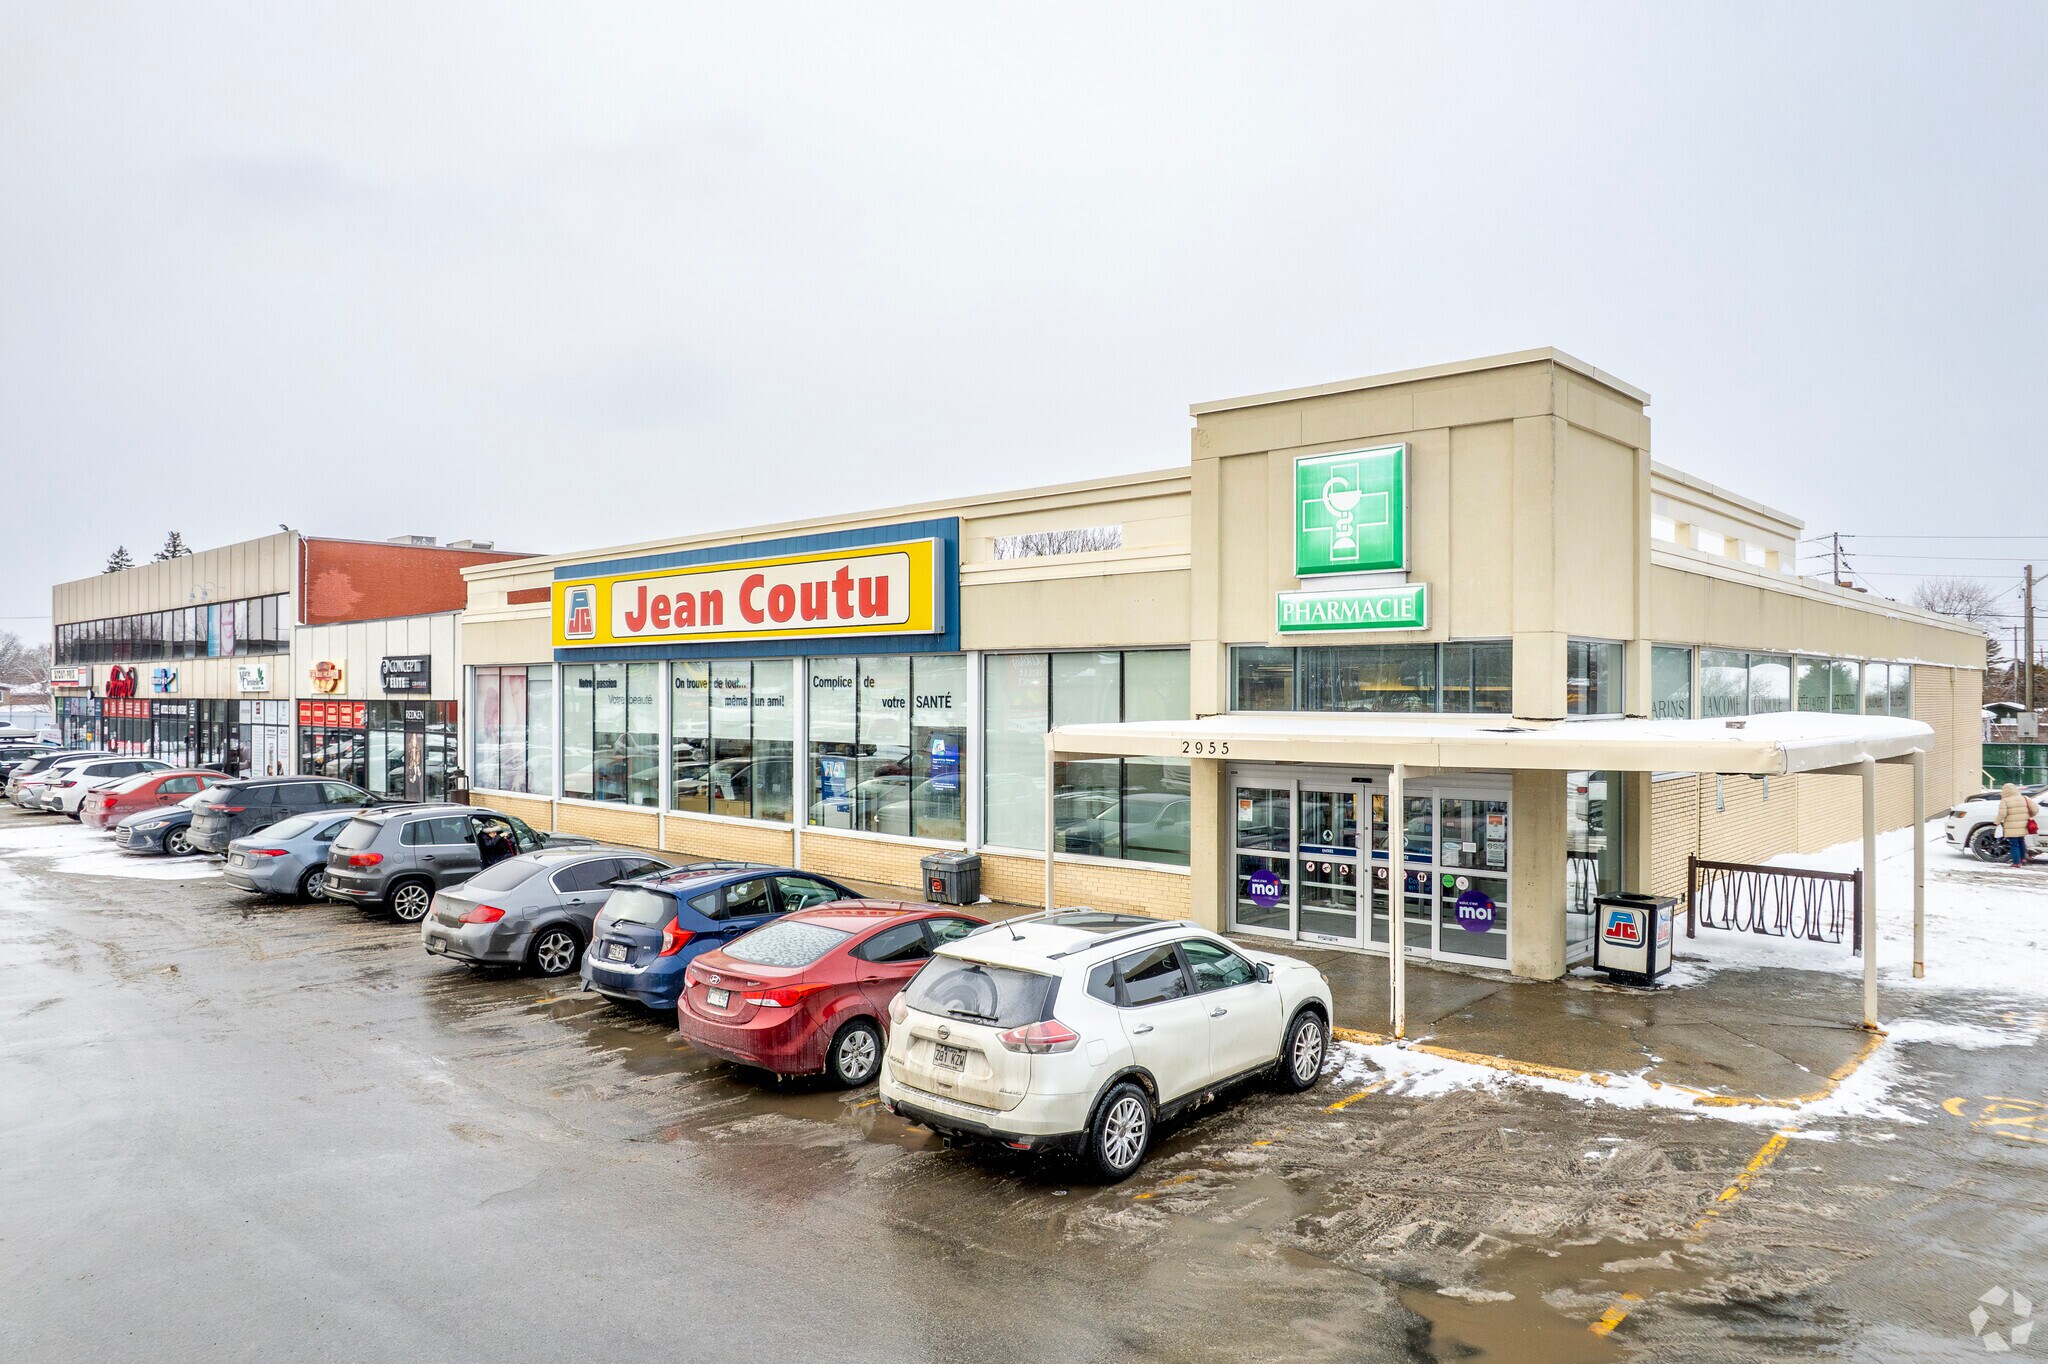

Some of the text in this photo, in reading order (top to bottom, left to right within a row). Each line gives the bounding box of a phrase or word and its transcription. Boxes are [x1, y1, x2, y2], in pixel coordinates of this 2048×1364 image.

[624, 565, 889, 632] Jean Coutu
[1283, 597, 1412, 622] PHARMACIE
[675, 677, 685, 689] On
[686, 677, 708, 689] trouve
[713, 677, 723, 689] de
[813, 675, 875, 691] Complice de
[608, 694, 653, 705] Votre beauté
[724, 694, 785, 707] même un ami!
[881, 691, 952, 709] votre SANTÉ
[405, 709, 424, 720] REDKEN
[1651, 699, 1685, 719] ARINS
[1182, 740, 1230, 755] 2955
[1251, 879, 1279, 897] moi
[1458, 902, 1492, 921] moi
[934, 1049, 948, 1063] Z81
